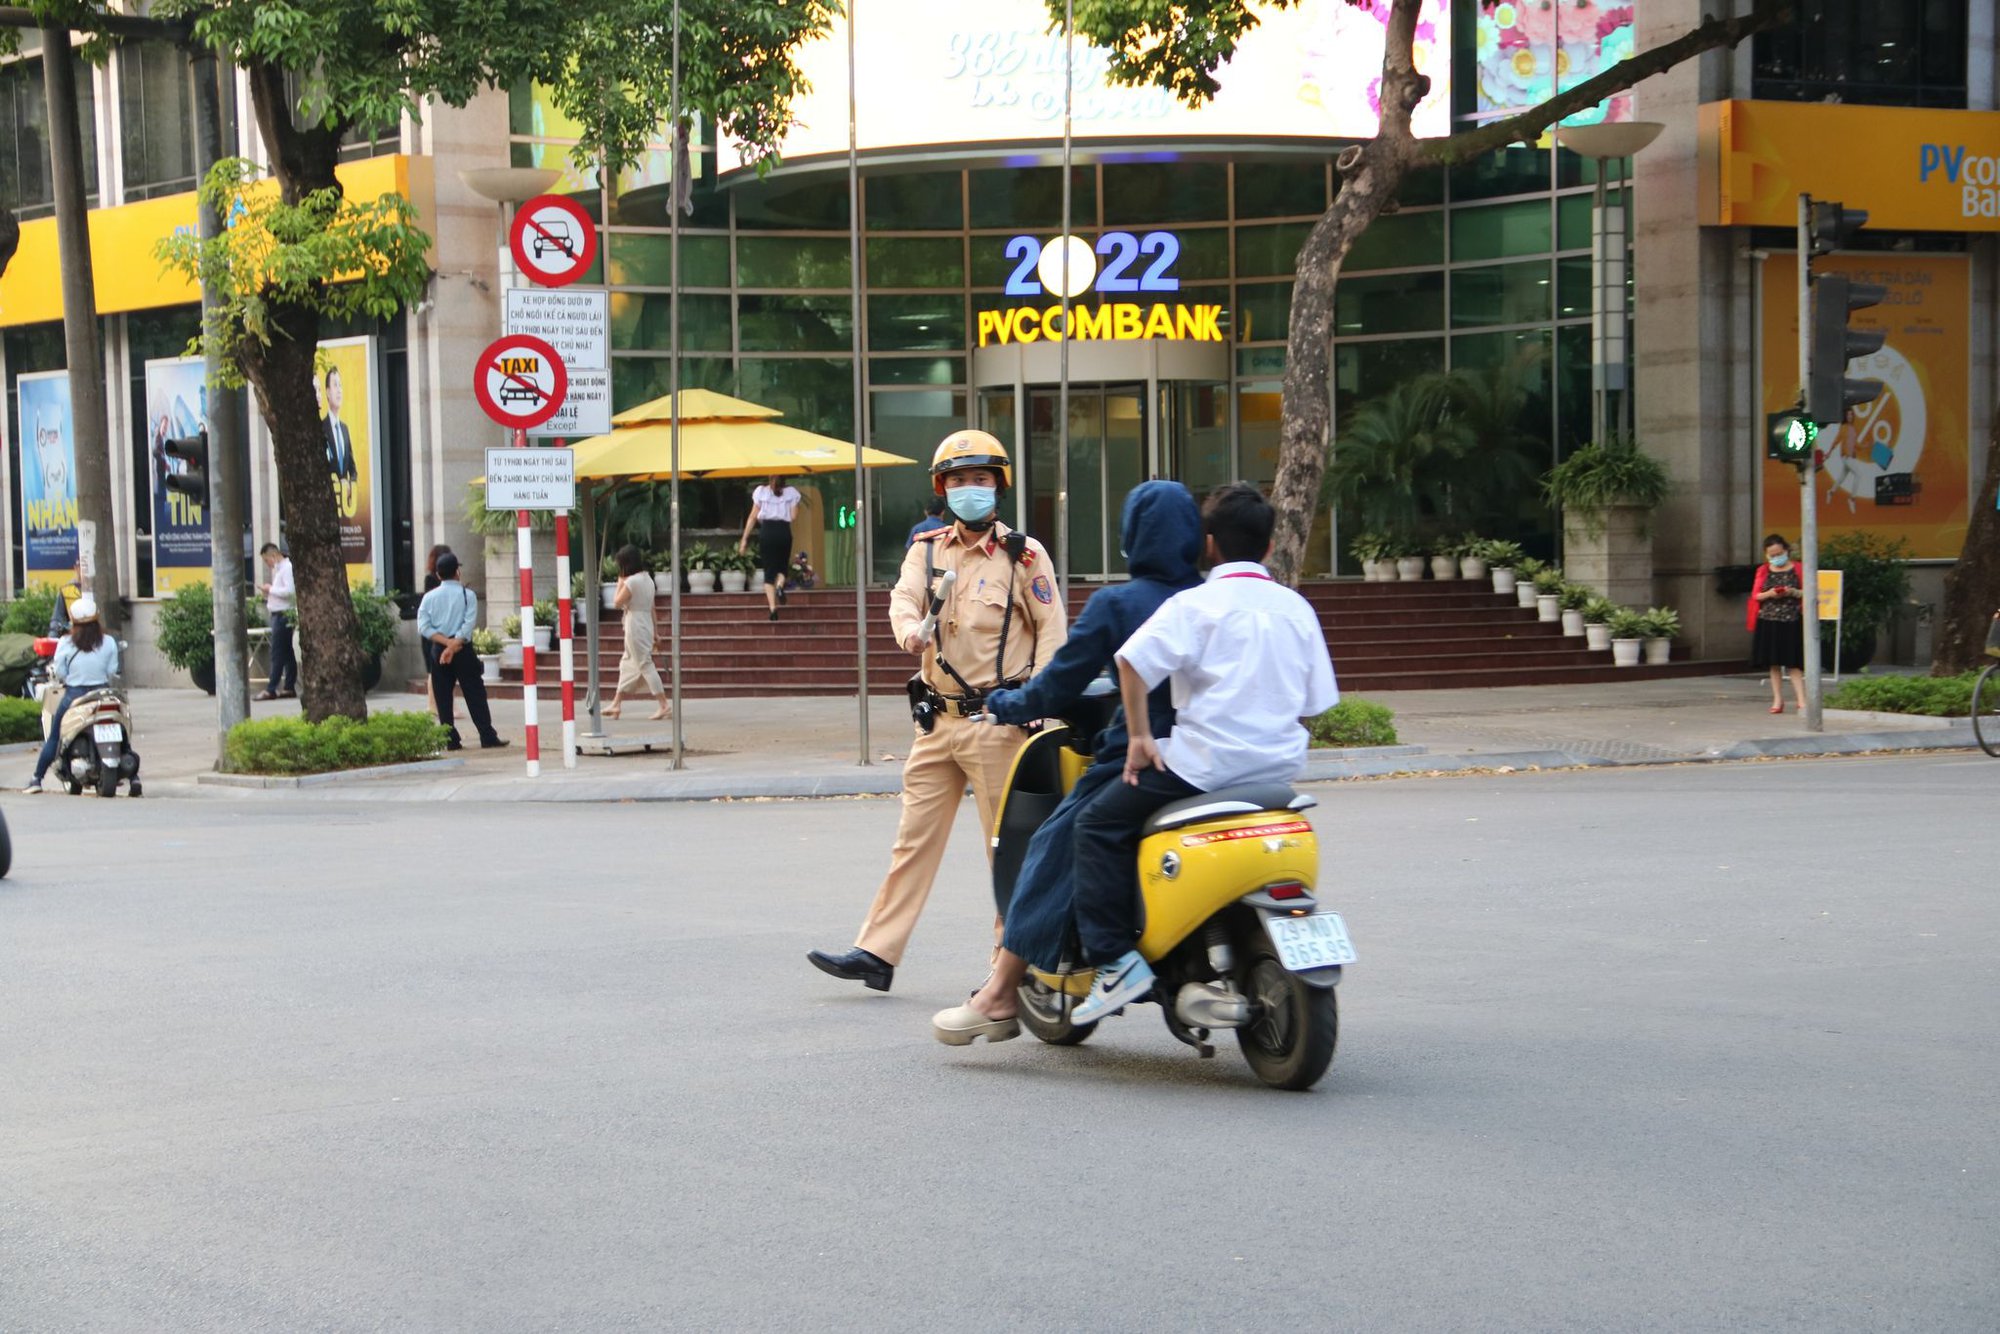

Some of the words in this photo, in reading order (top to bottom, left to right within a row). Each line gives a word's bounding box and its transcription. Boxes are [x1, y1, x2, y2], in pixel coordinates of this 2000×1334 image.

[943, 30, 1035, 79] 365
[1005, 231, 1179, 298] 2022
[523, 296, 531, 305] XE
[584, 297, 592, 306] 09
[978, 303, 1222, 347] PVCOMBANK
[501, 357, 539, 373] TAXI
[546, 421, 577, 432] Except
